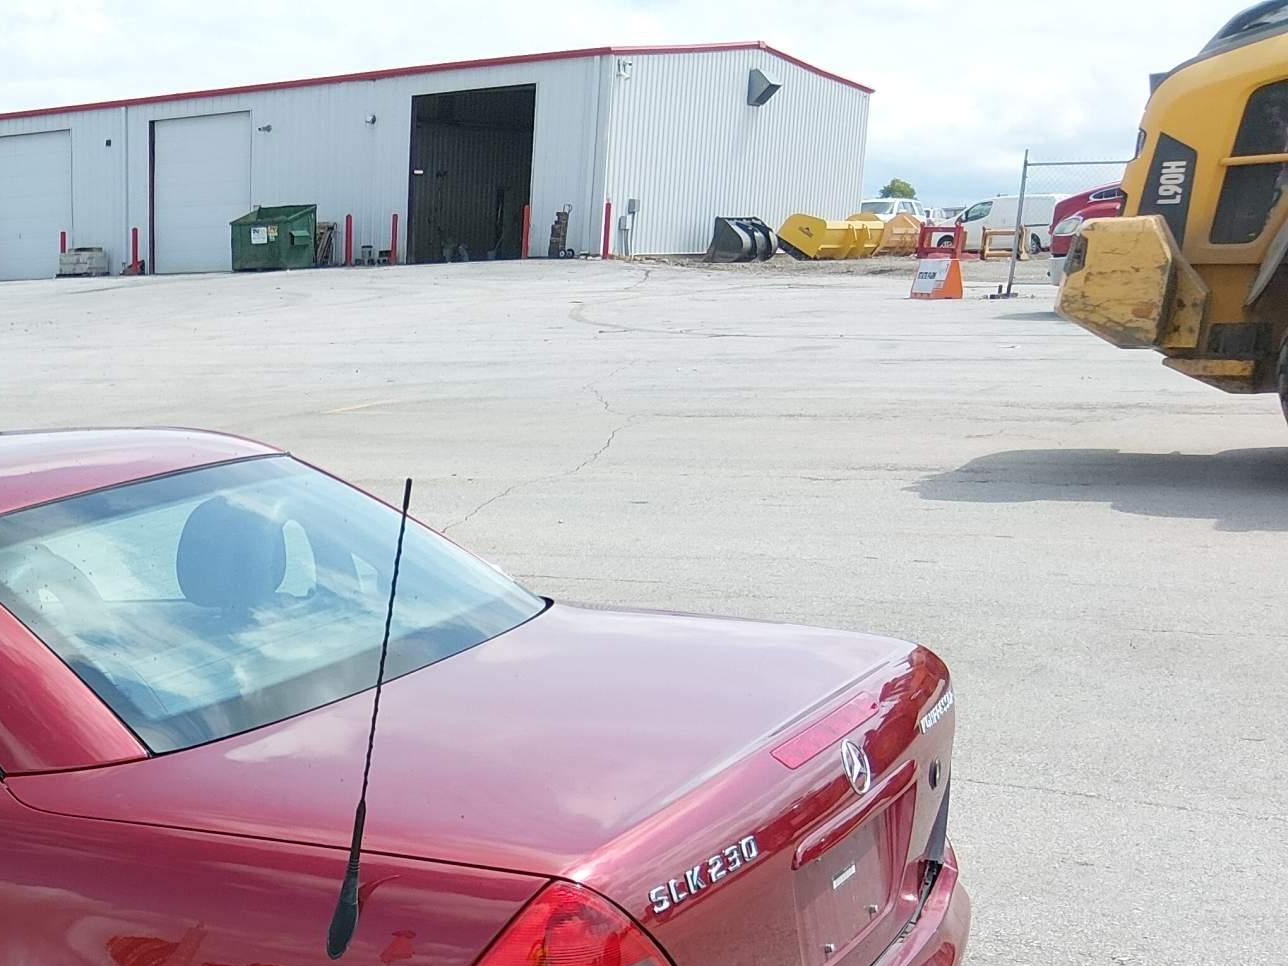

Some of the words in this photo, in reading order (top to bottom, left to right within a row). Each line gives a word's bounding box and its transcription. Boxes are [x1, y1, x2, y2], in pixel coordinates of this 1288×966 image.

[1156, 161, 1187, 205] L90H
[648, 865, 707, 914] SLK
[707, 835, 759, 883] 230
